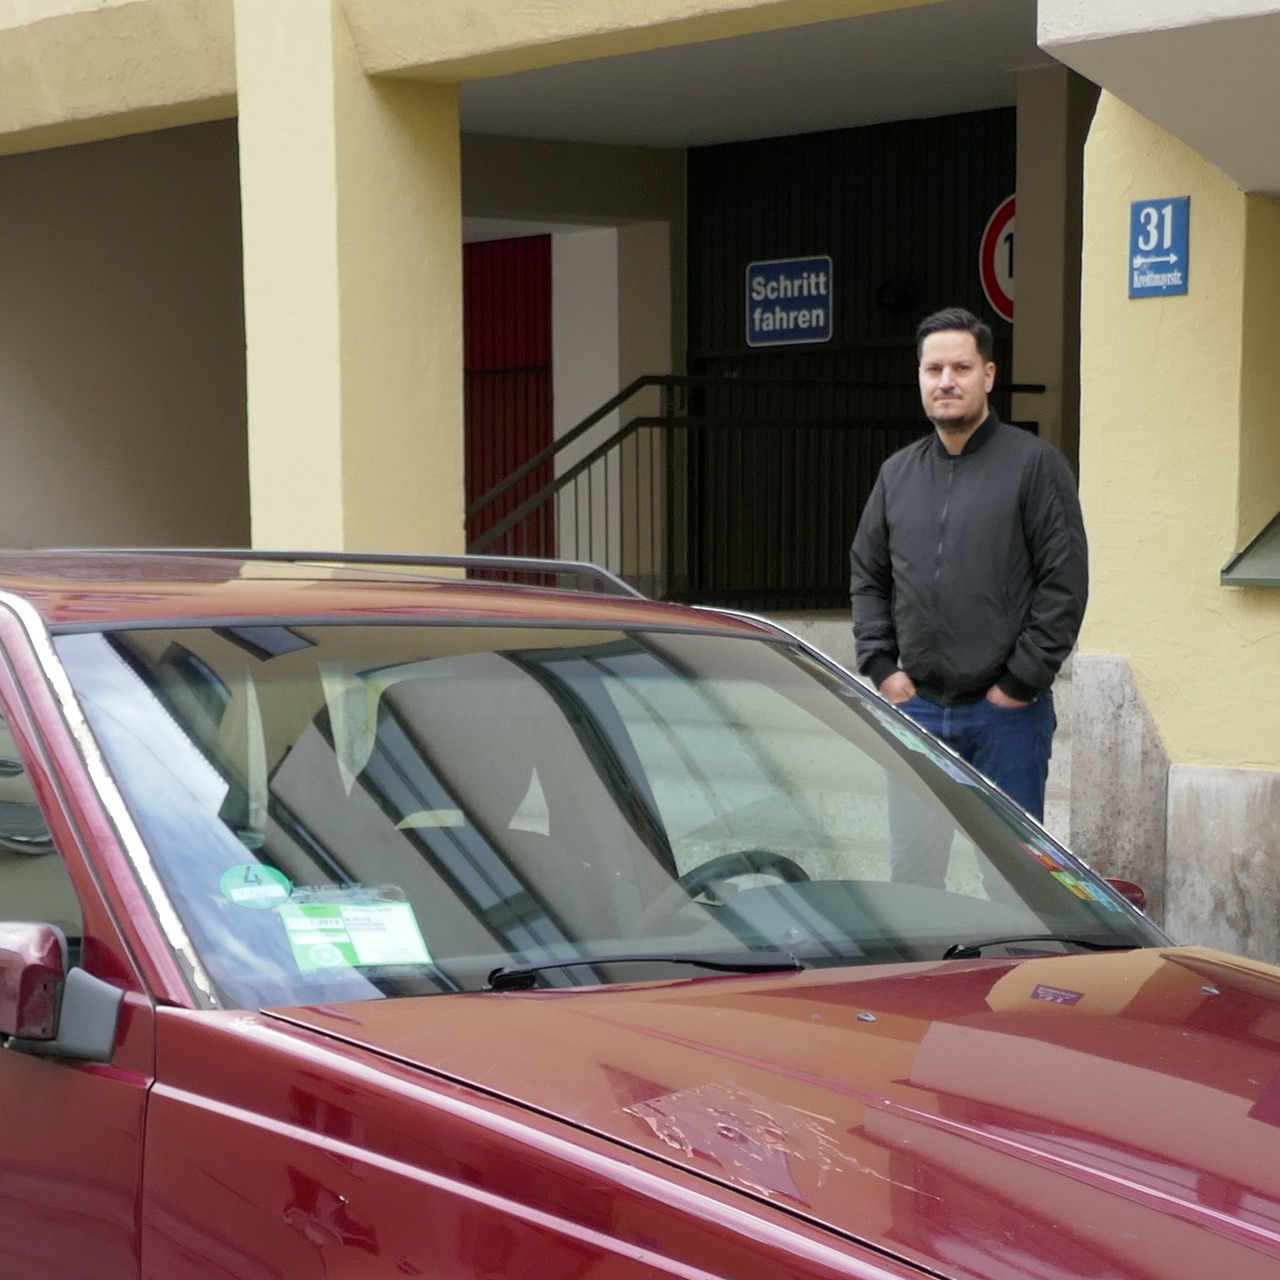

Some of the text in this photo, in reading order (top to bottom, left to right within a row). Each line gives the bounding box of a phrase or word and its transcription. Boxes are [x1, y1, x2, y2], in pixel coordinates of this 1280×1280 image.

[1138, 204, 1173, 251] 31
[1003, 232, 1014, 279] 1
[751, 272, 827, 301] Schritt
[753, 306, 825, 332] fahren
[243, 866, 262, 885] 4
